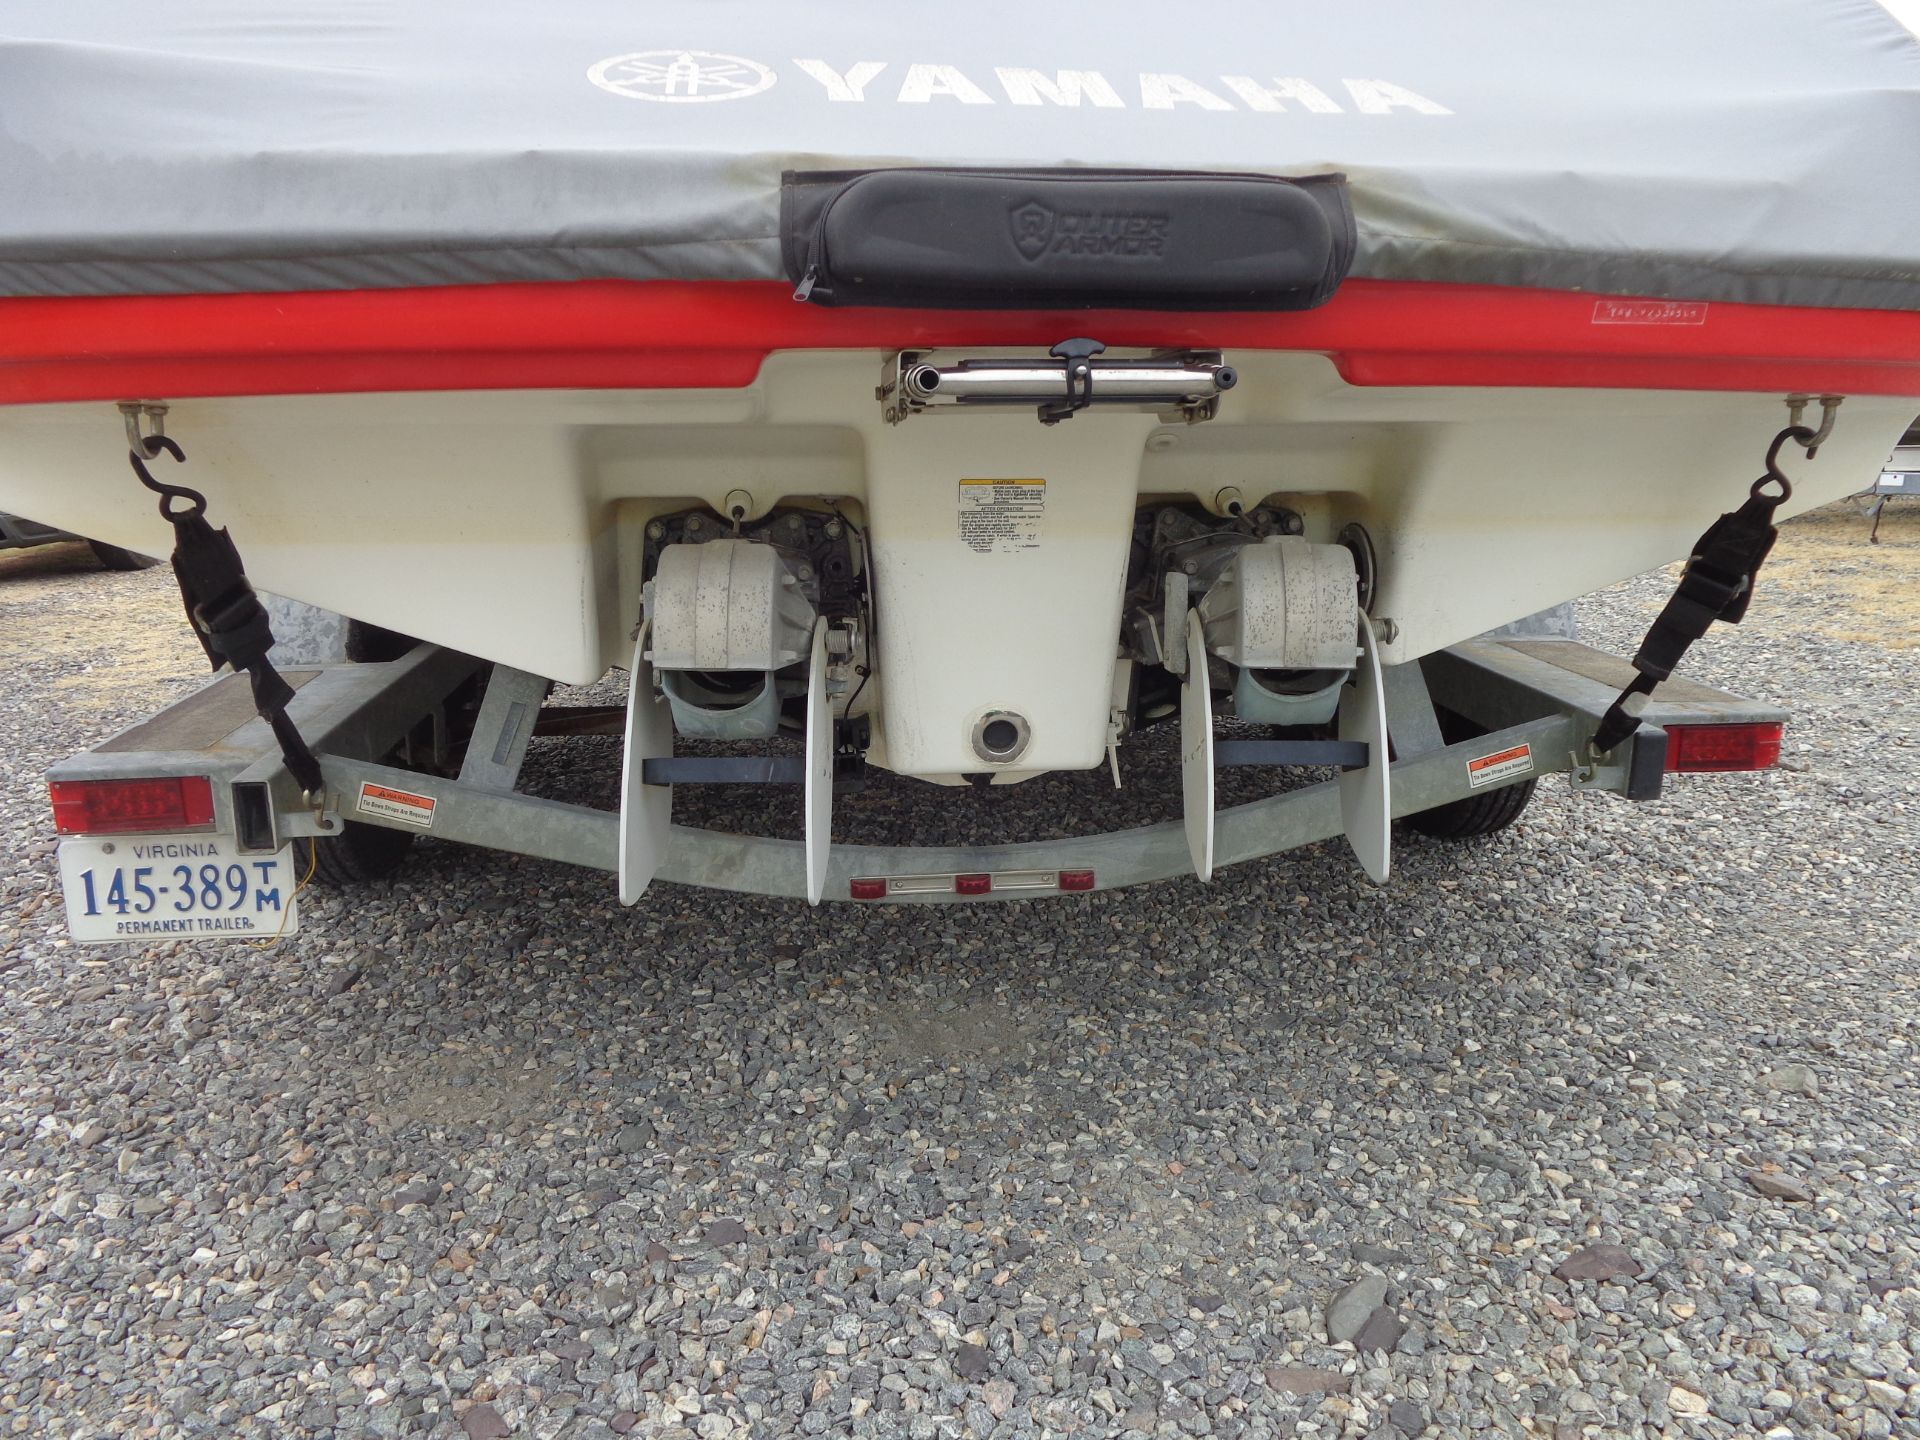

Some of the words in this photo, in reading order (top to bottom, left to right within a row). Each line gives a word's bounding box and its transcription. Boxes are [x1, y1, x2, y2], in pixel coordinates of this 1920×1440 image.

[792, 58, 1456, 115] YAMAHA
[1056, 211, 1169, 236] OUTER
[1051, 235, 1165, 257] ARMOR
[386, 792, 420, 804] WARNING
[133, 843, 219, 859] VIRGINIA
[80, 863, 248, 916] 145-389
[117, 918, 193, 935] PERMANENT
[198, 916, 250, 931] TRAILER
